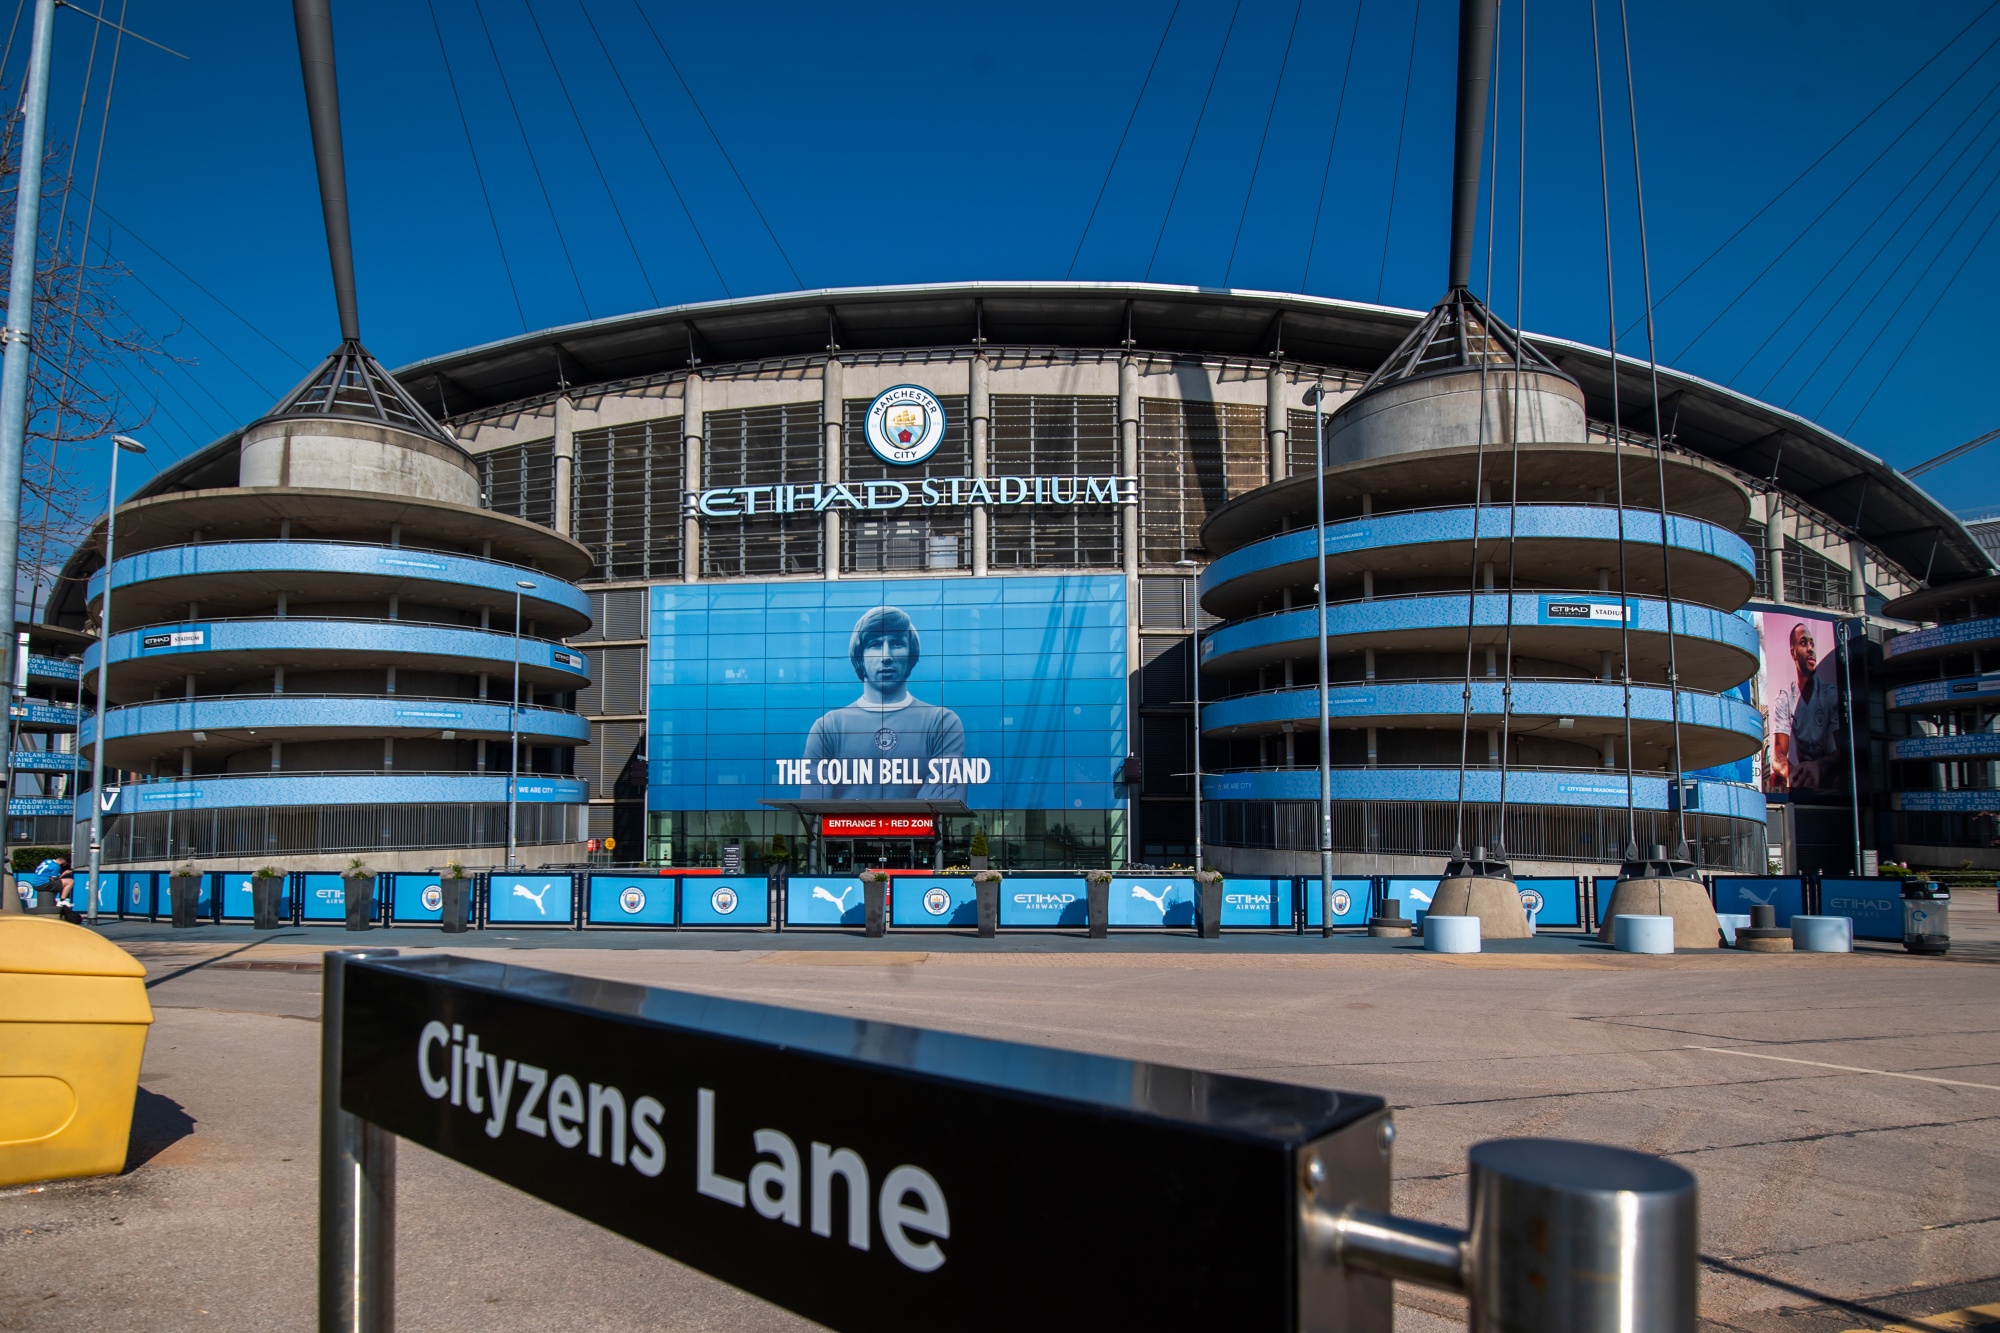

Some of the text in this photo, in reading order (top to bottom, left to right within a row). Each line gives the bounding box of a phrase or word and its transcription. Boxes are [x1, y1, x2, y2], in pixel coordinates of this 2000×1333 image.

[874, 390, 937, 416] MANCHESTER
[700, 476, 1119, 516] ETIHAD STADIUM
[1952, 619, 1994, 631] CITYZENS
[144, 636, 170, 645] ETIHAD
[1950, 632, 1994, 644] MIDLANDS
[32, 668, 65, 678] YORKSHIRE
[1919, 694, 1948, 702] CHEADLE
[1926, 736, 1974, 745] CHADDERTON
[1930, 748, 1968, 756] RUSHOLME
[776, 758, 990, 785] THE COLIN BELL STAND
[101, 793, 118, 810] V
[828, 820, 876, 828] ENTRANCE
[890, 820, 910, 828] RED
[1014, 894, 1076, 904] ETIHAD
[1226, 894, 1280, 904] ETIHAD
[1830, 898, 1892, 910] ETIHAD
[418, 1020, 950, 1273] Cityzens Lane
